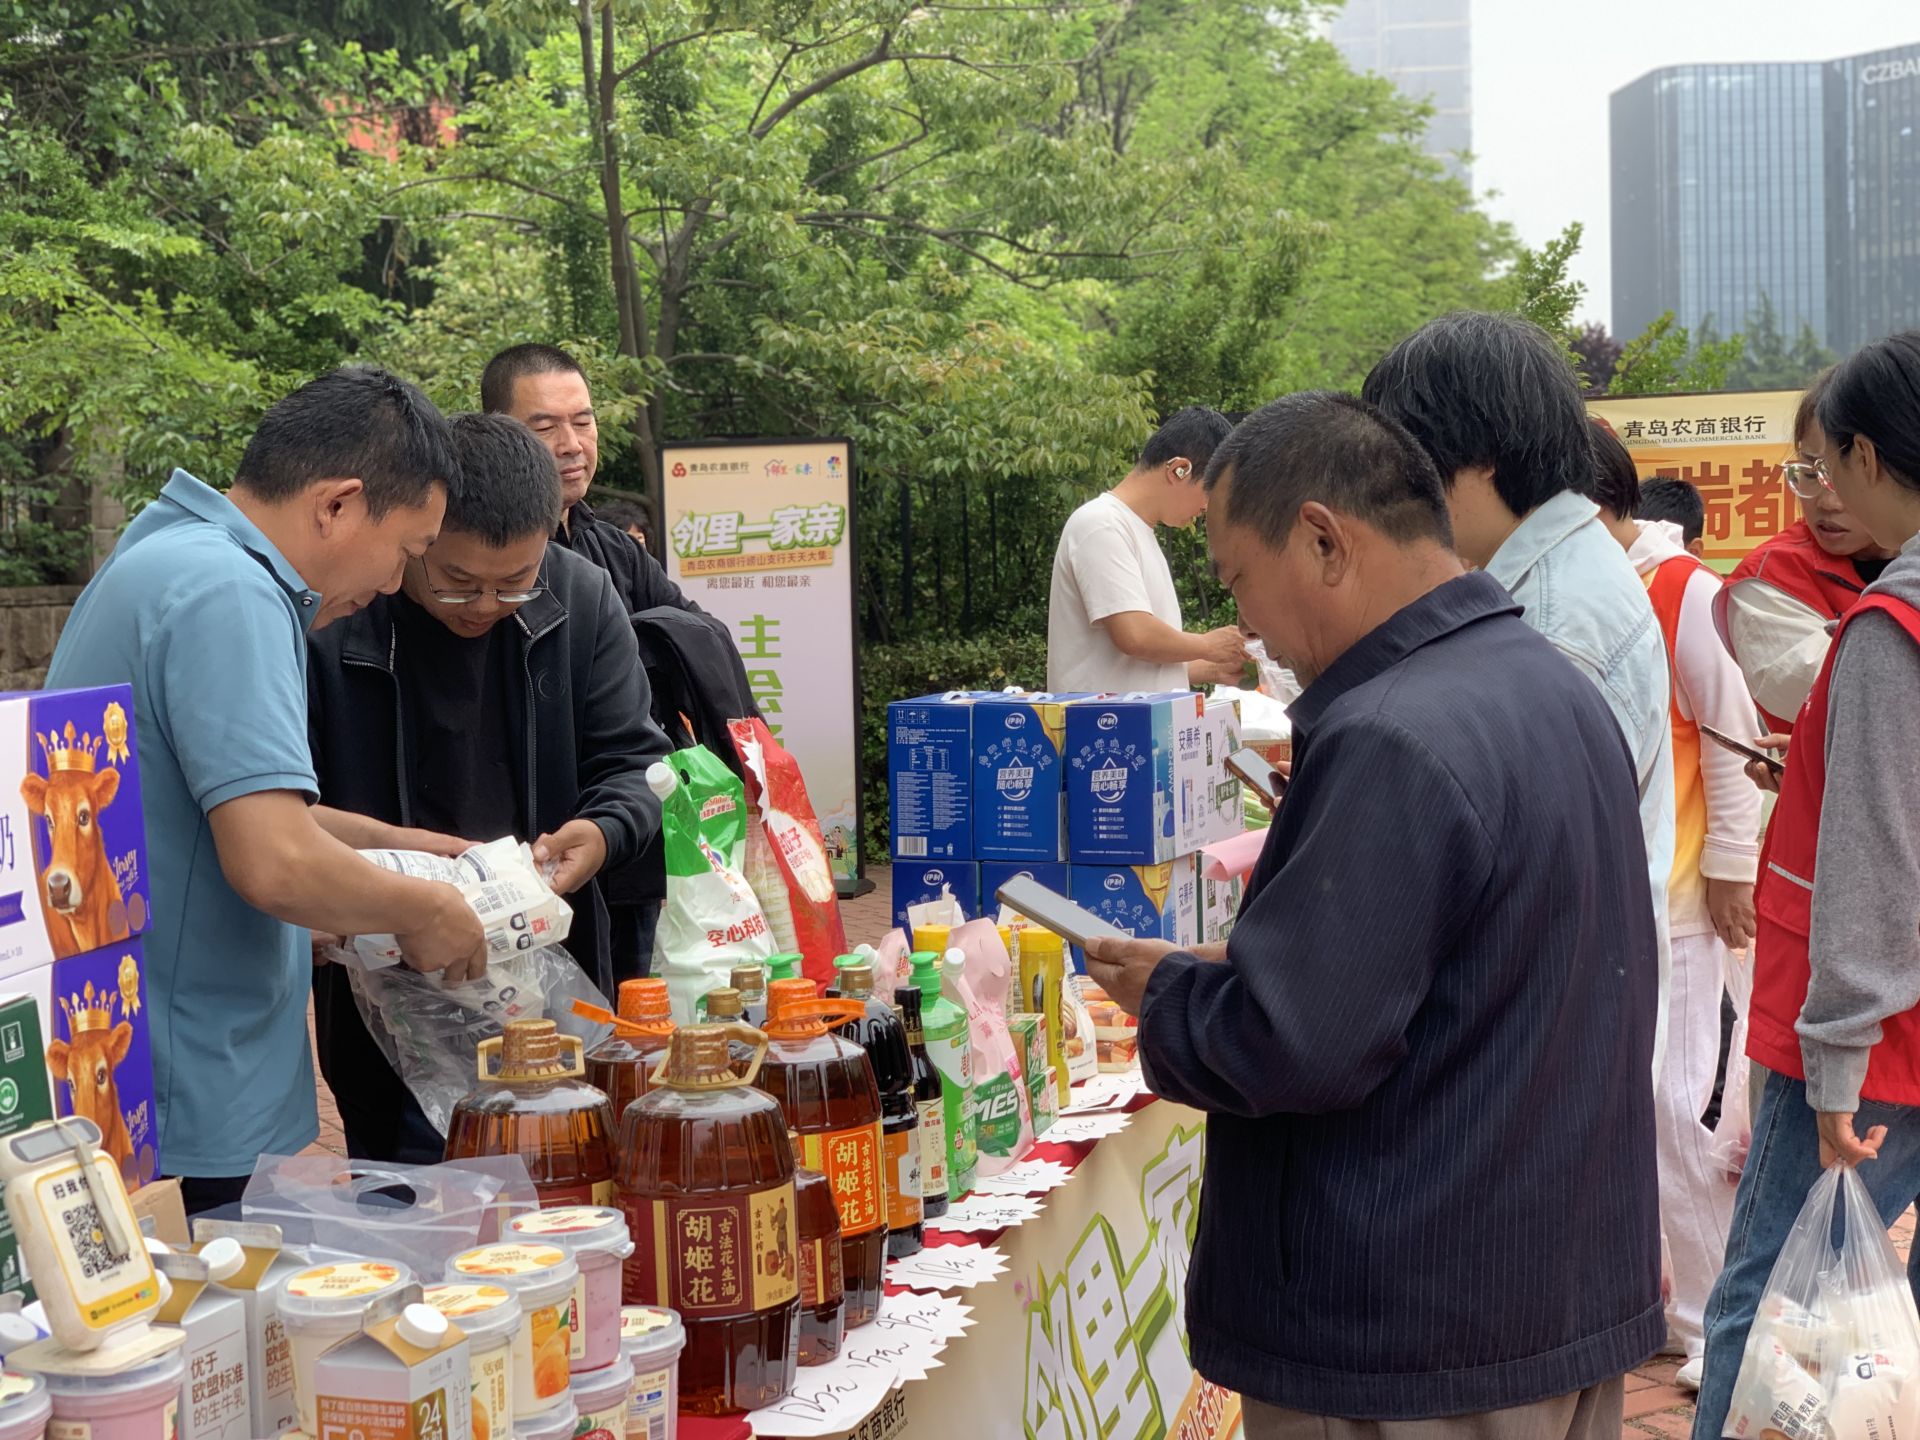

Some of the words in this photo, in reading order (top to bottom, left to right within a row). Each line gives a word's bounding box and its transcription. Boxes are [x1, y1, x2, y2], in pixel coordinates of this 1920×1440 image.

[1862, 57, 1920, 85] CZBA
[1624, 415, 1766, 439] 青岛农商银行
[1689, 435, 1743, 443] COMMERCIAL
[671, 502, 844, 557] 邻里一家亲
[707, 576, 755, 590] 离您最近
[762, 575, 812, 588] 和您最亲
[739, 614, 784, 748] 主会
[999, 768, 1033, 780] 营养美味
[1092, 769, 1127, 781] 营养美味
[835, 1140, 861, 1226] 胡姬花
[861, 1141, 875, 1217] 古法花生油
[683, 1215, 716, 1304] 胡姬花
[718, 1217, 736, 1297] 古法花生油
[191, 1350, 218, 1380] 优于
[192, 1361, 244, 1405] 欧盟标准
[194, 1386, 246, 1428] 的生牛乳
[419, 1397, 442, 1436] 24
